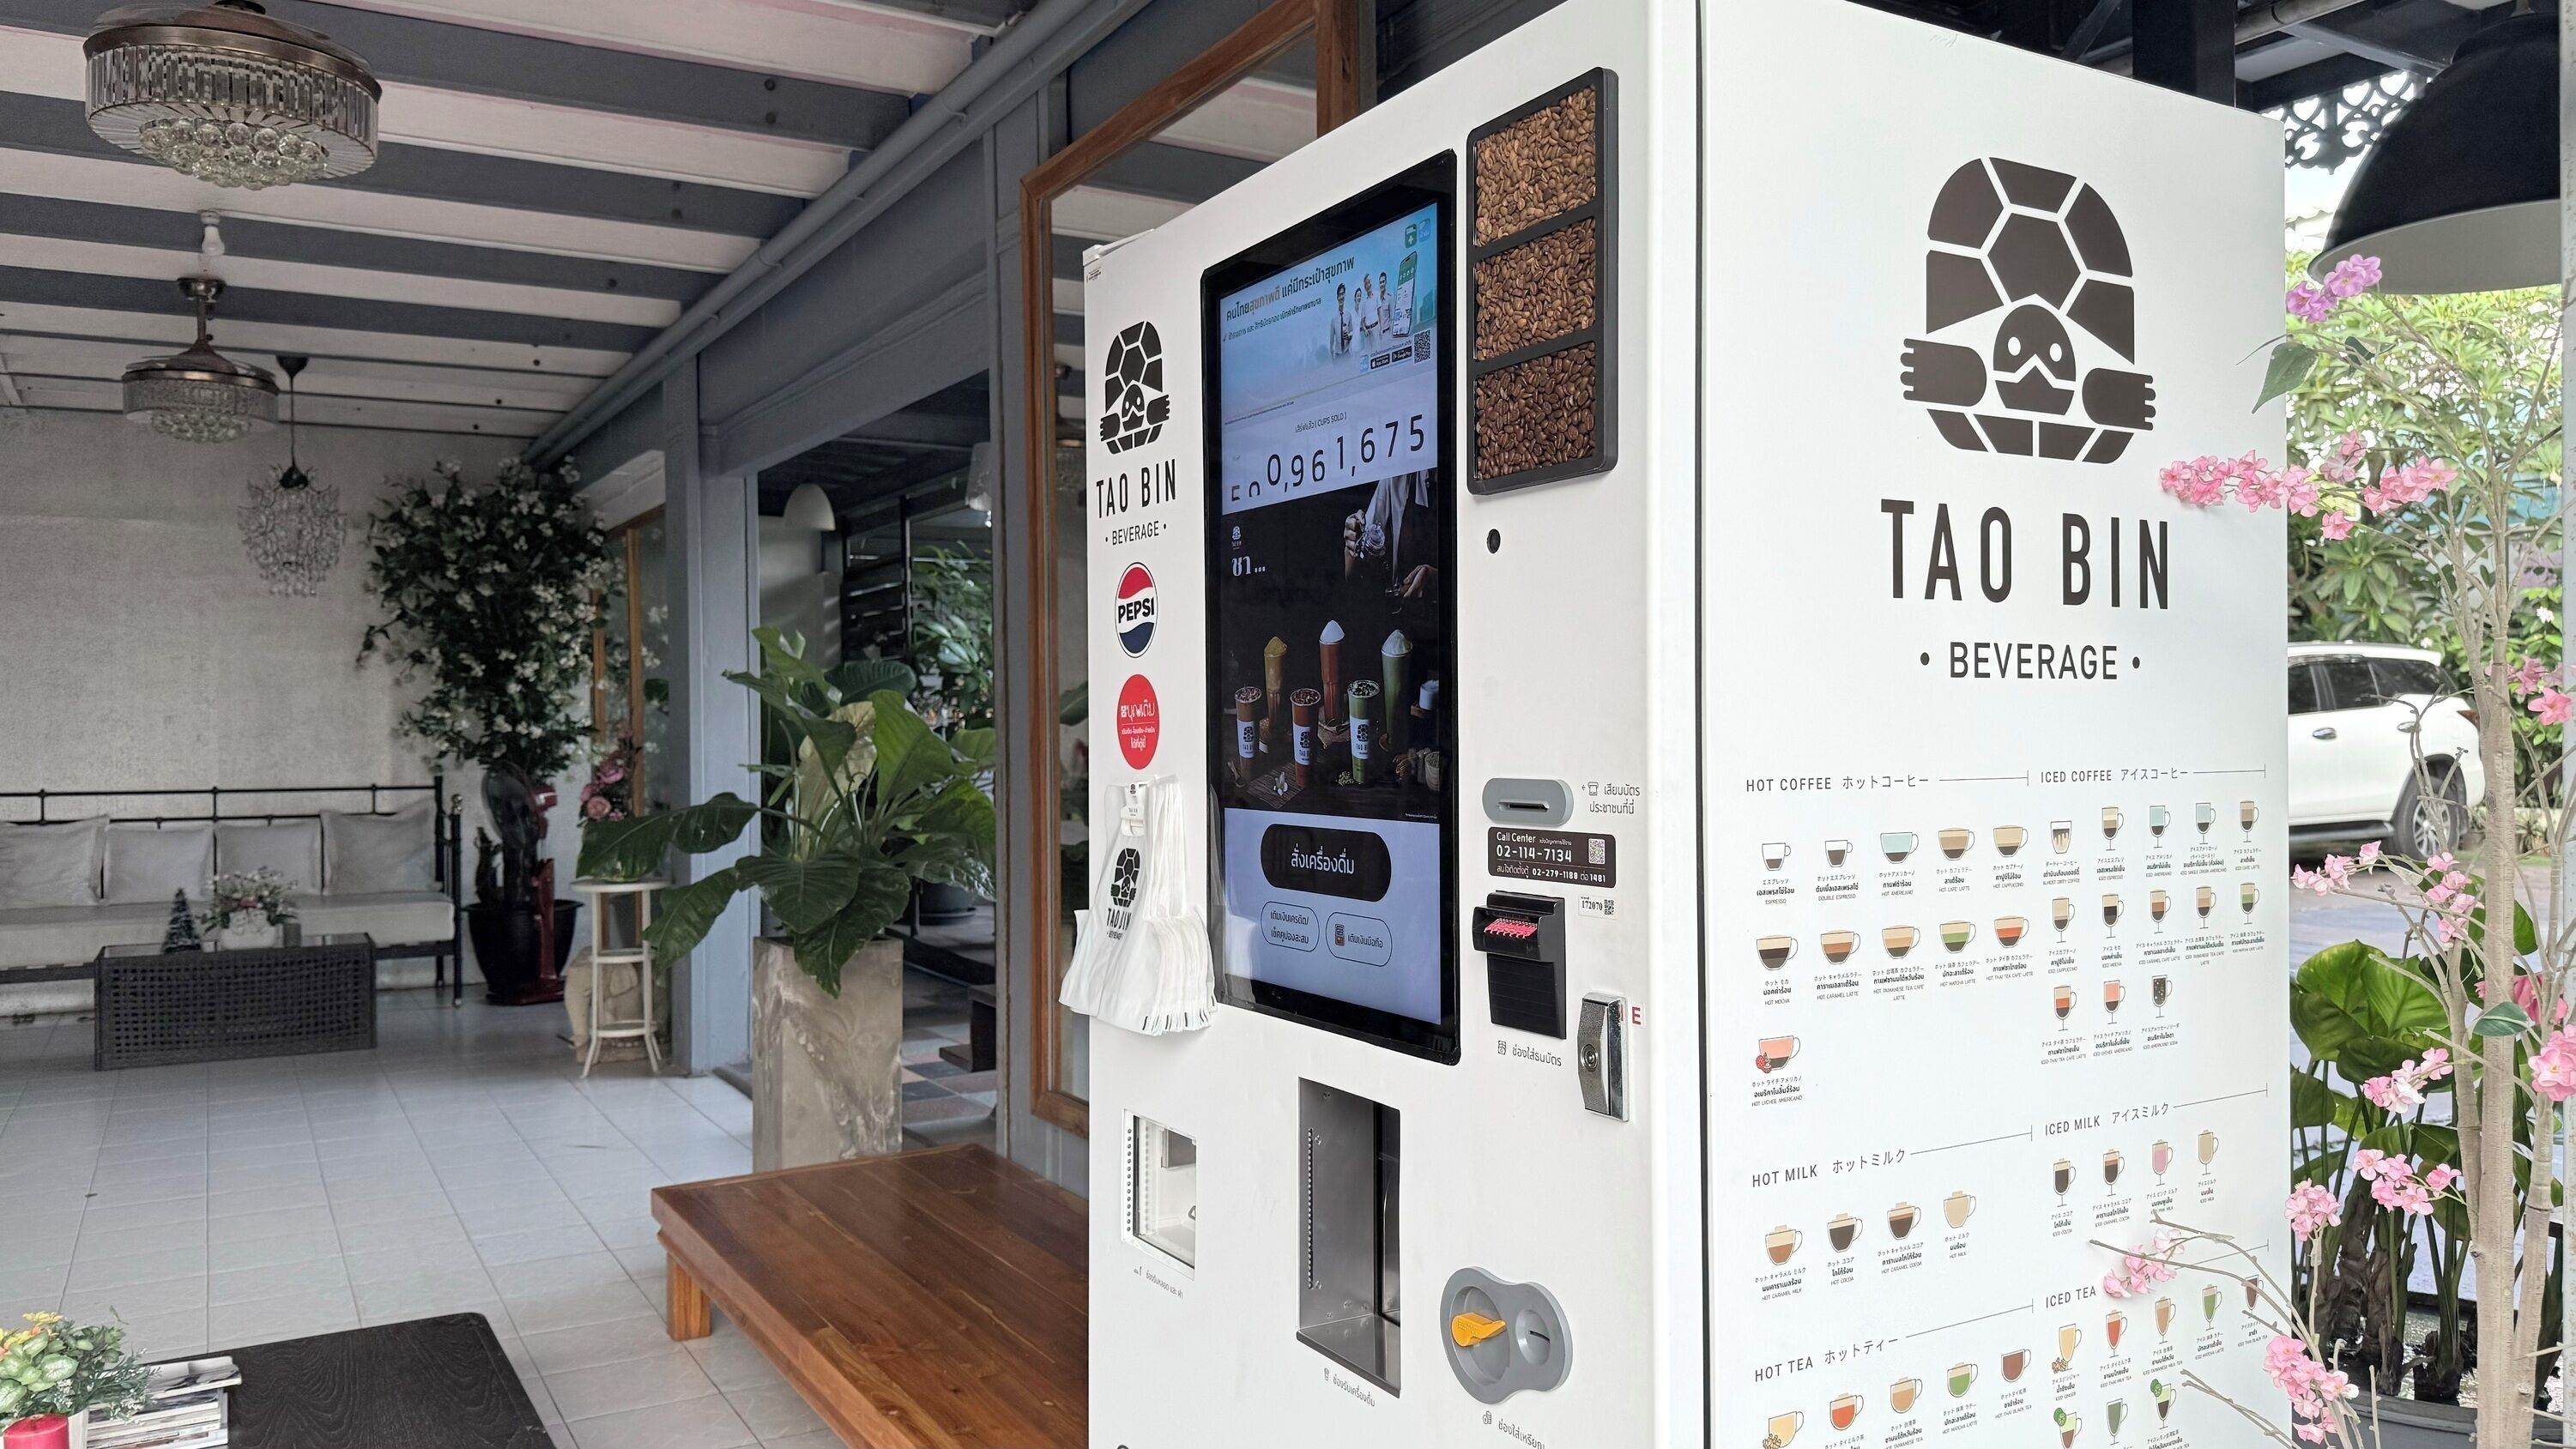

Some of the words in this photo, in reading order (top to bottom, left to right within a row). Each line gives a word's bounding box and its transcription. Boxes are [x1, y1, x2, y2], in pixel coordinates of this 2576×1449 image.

[1317, 416, 1330, 427] CUPS
[1331, 414, 1344, 424] SOLD
[1097, 474, 1128, 518] TAO
[1141, 459, 1176, 508] BIN
[1112, 521, 1159, 546] BEVERAGE
[1882, 498, 2011, 603] TAO
[2063, 512, 2168, 610] BIN
[1118, 597, 1154, 624] PEPSI
[1950, 643, 2118, 679] BEVERAGE
[1746, 779, 1774, 792] HOT
[1780, 777, 1831, 791] COFFEE
[1843, 775, 1929, 789] ホットコーヒー
[2041, 770, 2066, 783] ICED
[2071, 770, 2112, 782] COFFEE
[2120, 767, 2188, 782] アイスコーヒー
[1604, 783, 1640, 797] เสียบบัตร
[1589, 799, 1635, 814] ประชาชนที่นี่
[1497, 832, 1509, 842] Call
[1512, 833, 1536, 844] Center
[1291, 843, 1354, 875] สั่งเครื่องดื่ม
[1497, 845, 1572, 863] 02-114-7134
[1533, 868, 1578, 880] 02-279-1188
[1582, 901, 1602, 910] 172070
[1632, 1006, 1642, 1025] E
[1512, 1045, 1562, 1066] ช่องใส่ธนบัตร
[2045, 1120, 2070, 1136] ICED
[2074, 1115, 2100, 1131] MILK
[2112, 1102, 2169, 1125] アイスミルク
[1752, 1171, 1779, 1187] HOT
[1785, 1164, 1817, 1182] MILK
[1832, 1148, 1906, 1174] ホットミルク
[2046, 1291, 2071, 1309] ICED
[2076, 1285, 2096, 1301] TEA
[1755, 1363, 1782, 1383] HOT
[1787, 1355, 1814, 1374] TEA
[1824, 1337, 1899, 1365] ホットティー
